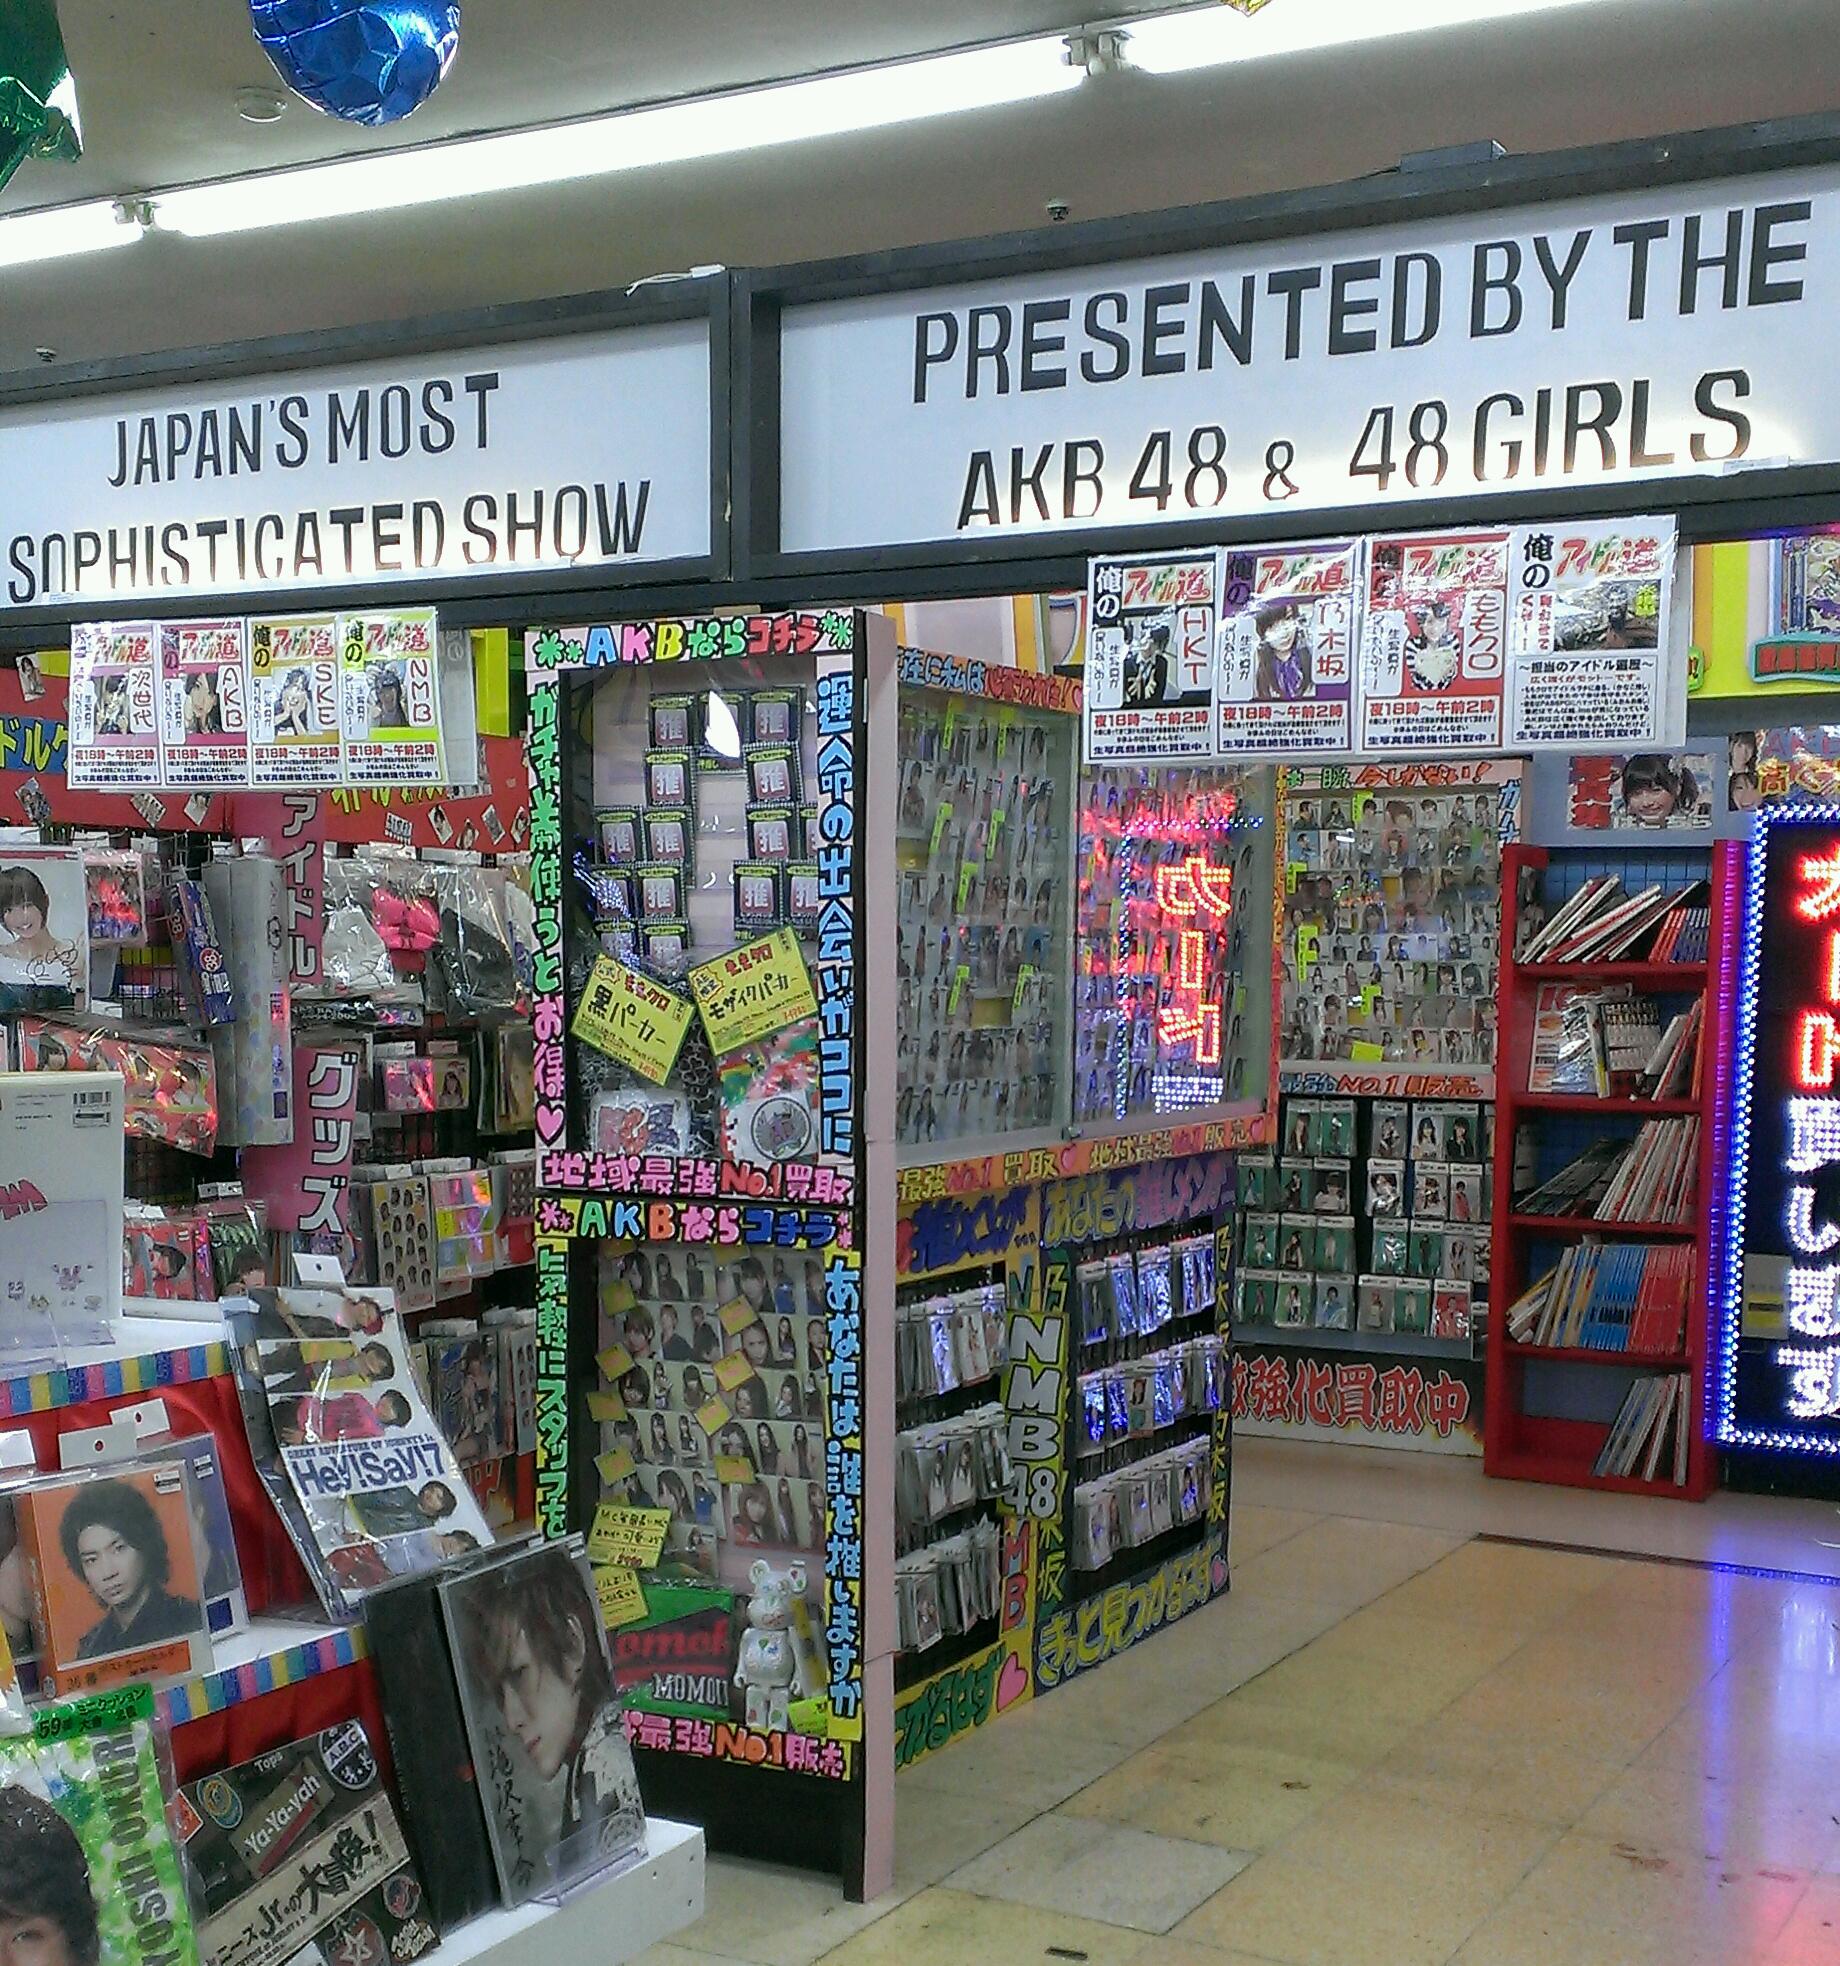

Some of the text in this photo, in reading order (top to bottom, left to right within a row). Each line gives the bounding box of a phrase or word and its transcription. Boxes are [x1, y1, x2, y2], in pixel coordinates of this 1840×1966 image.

[914, 200, 1814, 403] PRESENTED BY THE
[107, 372, 501, 488] JAPAN'S MOST
[956, 368, 1752, 531] AKB 48 & 48 GIRLS
[8, 480, 652, 603] SOPHISTICATED SHOW
[1522, 533, 1555, 588] 俺の
[1096, 567, 1122, 618] 俺の
[583, 613, 823, 666] AKBならコチラ
[1184, 611, 1207, 685] HKT
[1316, 604, 1346, 677] 乃木坂
[1468, 593, 1500, 671] ももクロ
[132, 670, 154, 729] 次世代
[223, 667, 244, 728] AKB
[315, 663, 336, 725] SKE
[410, 660, 432, 723] NMB
[283, 795, 317, 976] アイドル
[817, 671, 854, 1154] 運命の出会いがココに
[587, 984, 667, 1044] 黒パーカー
[708, 972, 800, 1020] モザイクパーカー
[298, 1051, 359, 1234] グッズ
[541, 1152, 853, 1204] 地域最強No.1買取
[578, 1201, 837, 1250] AKBならコチラ
[1004, 1314, 1064, 1519] NMB48
[290, 1442, 446, 1497] Hey!Say!7
